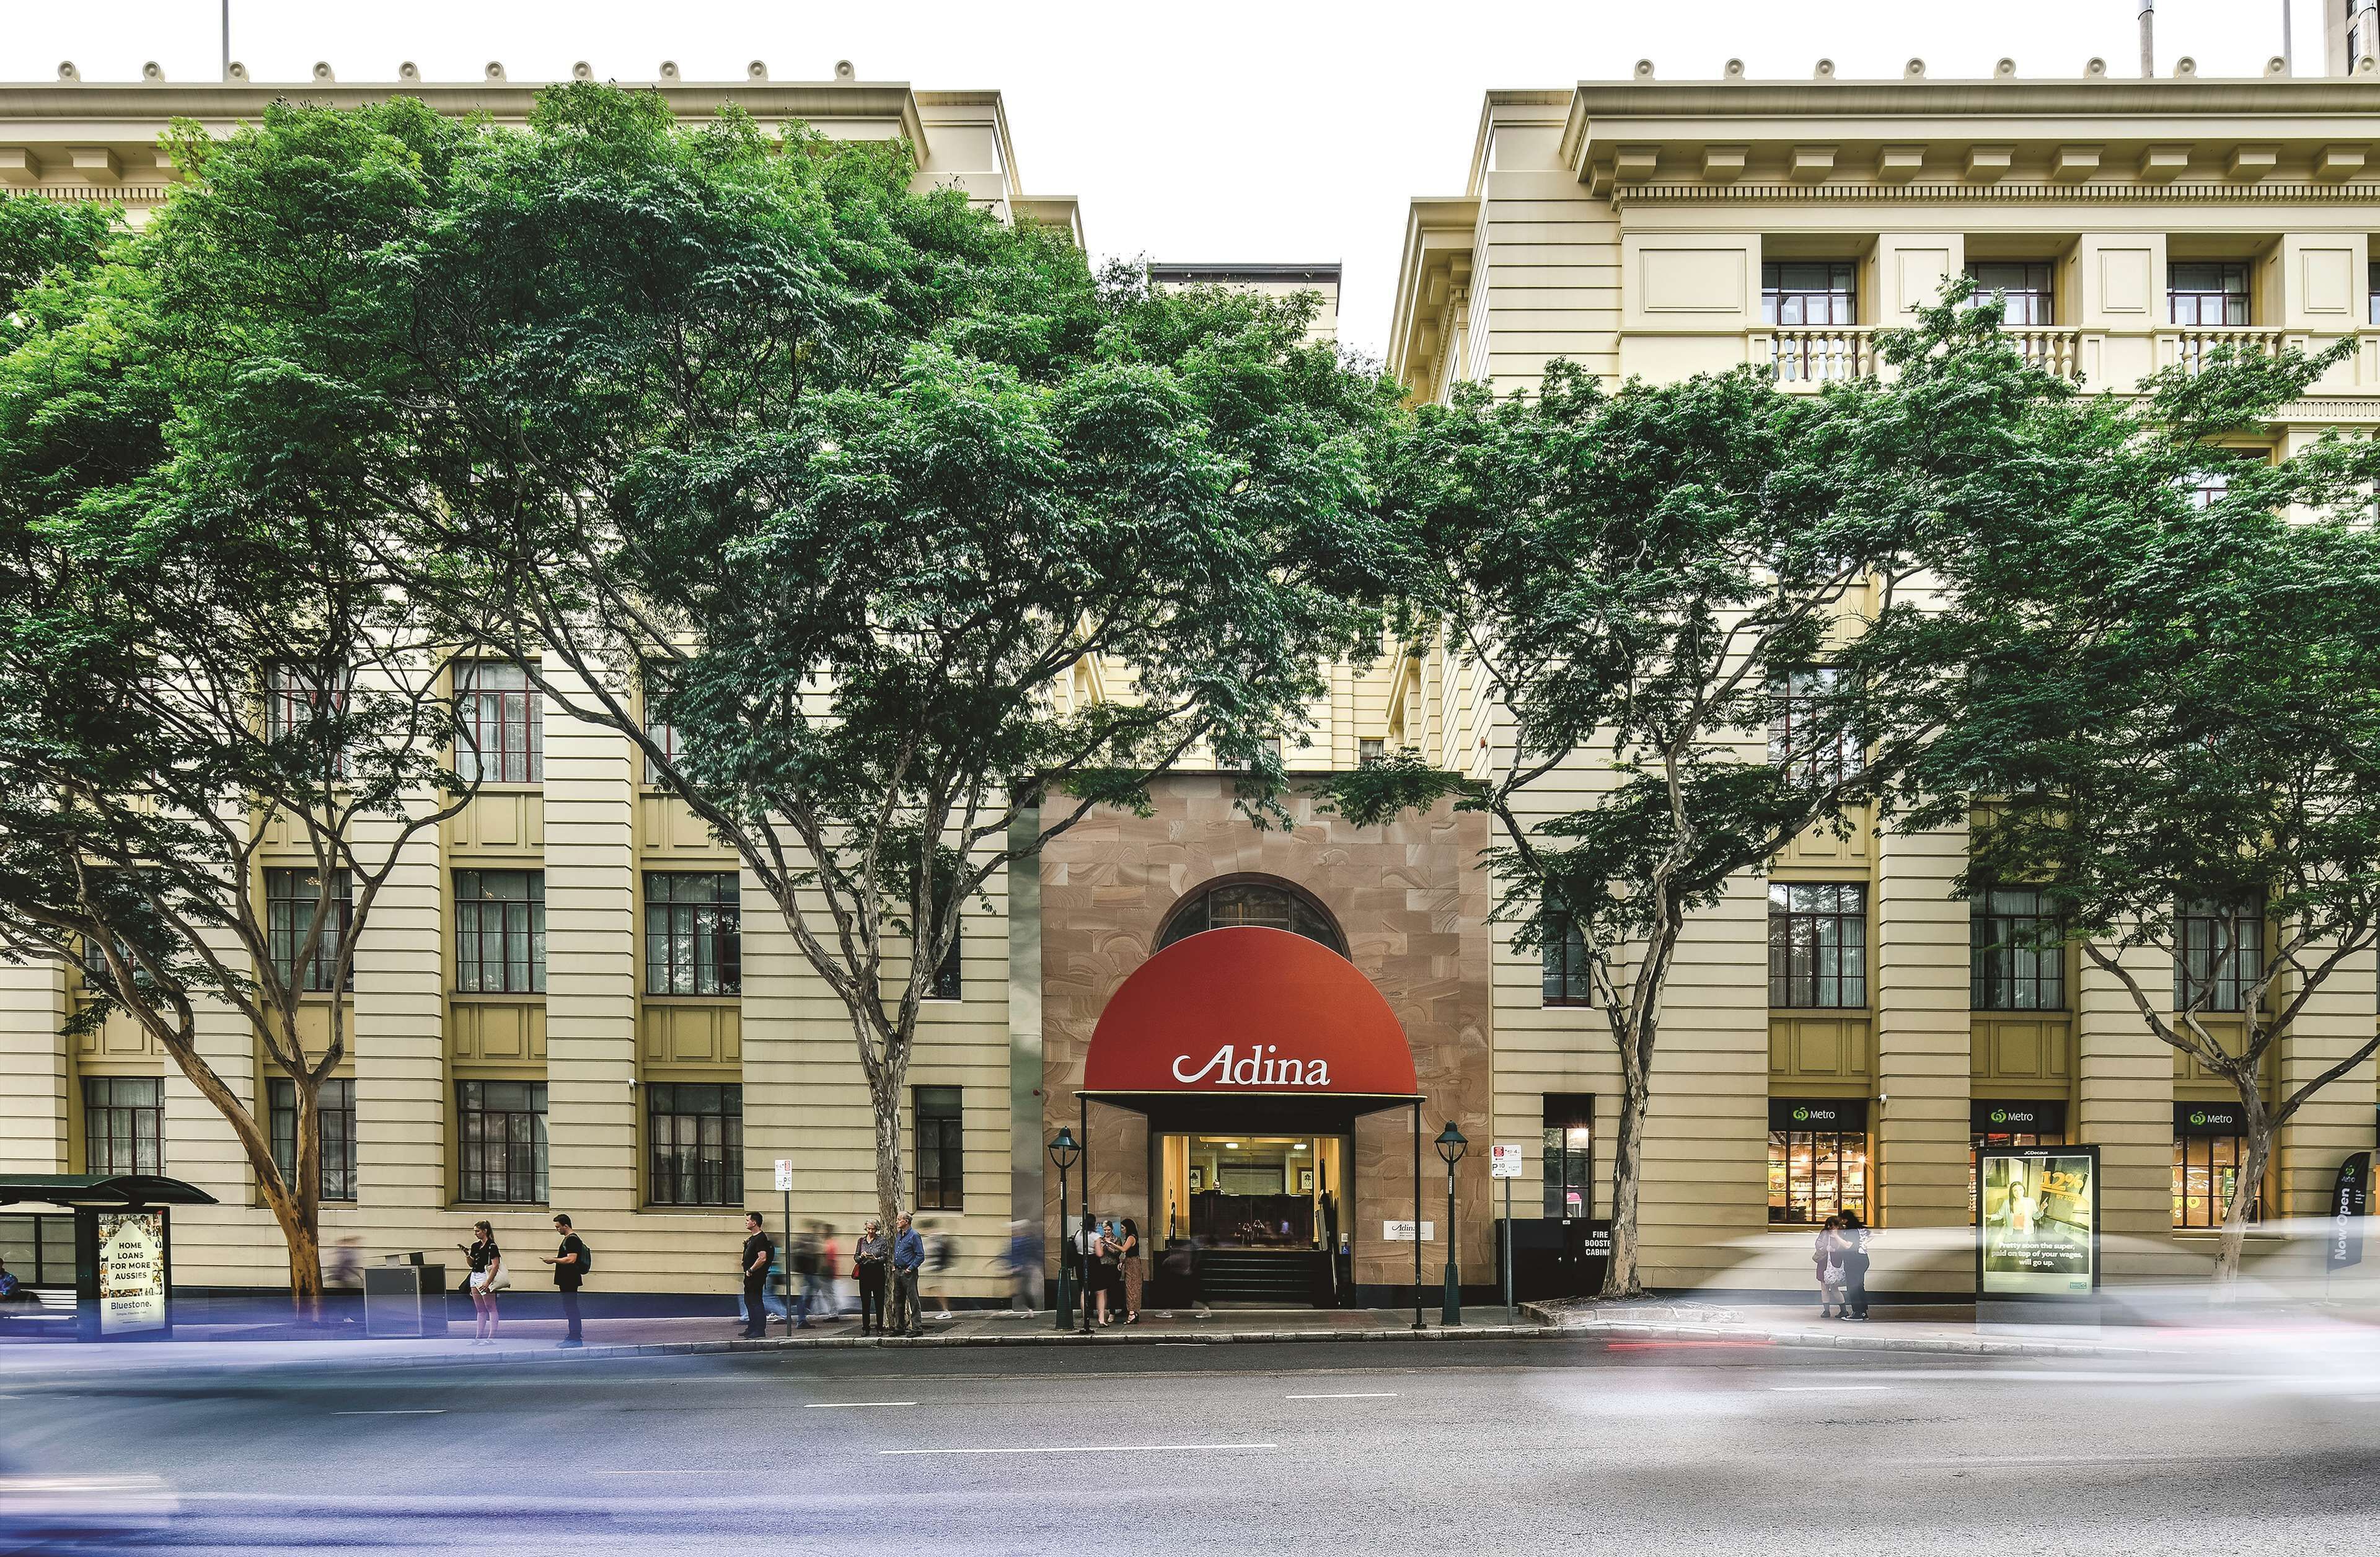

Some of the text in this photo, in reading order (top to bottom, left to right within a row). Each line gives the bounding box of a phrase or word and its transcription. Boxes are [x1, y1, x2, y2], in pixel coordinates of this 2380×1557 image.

[1173, 1044, 1331, 1085] Adina
[1810, 1110, 1835, 1119] Metro
[2008, 1112, 2034, 1121] Metro
[2207, 1113, 2232, 1124] Metro
[2040, 1170, 2084, 1191] 12%
[2334, 1188, 2351, 1260] Now Open
[2018, 1250, 2031, 1258] top
[110, 1262, 126, 1270] FOR
[115, 1272, 147, 1280] AUSSIES
[110, 1300, 152, 1310] Bluestone.
